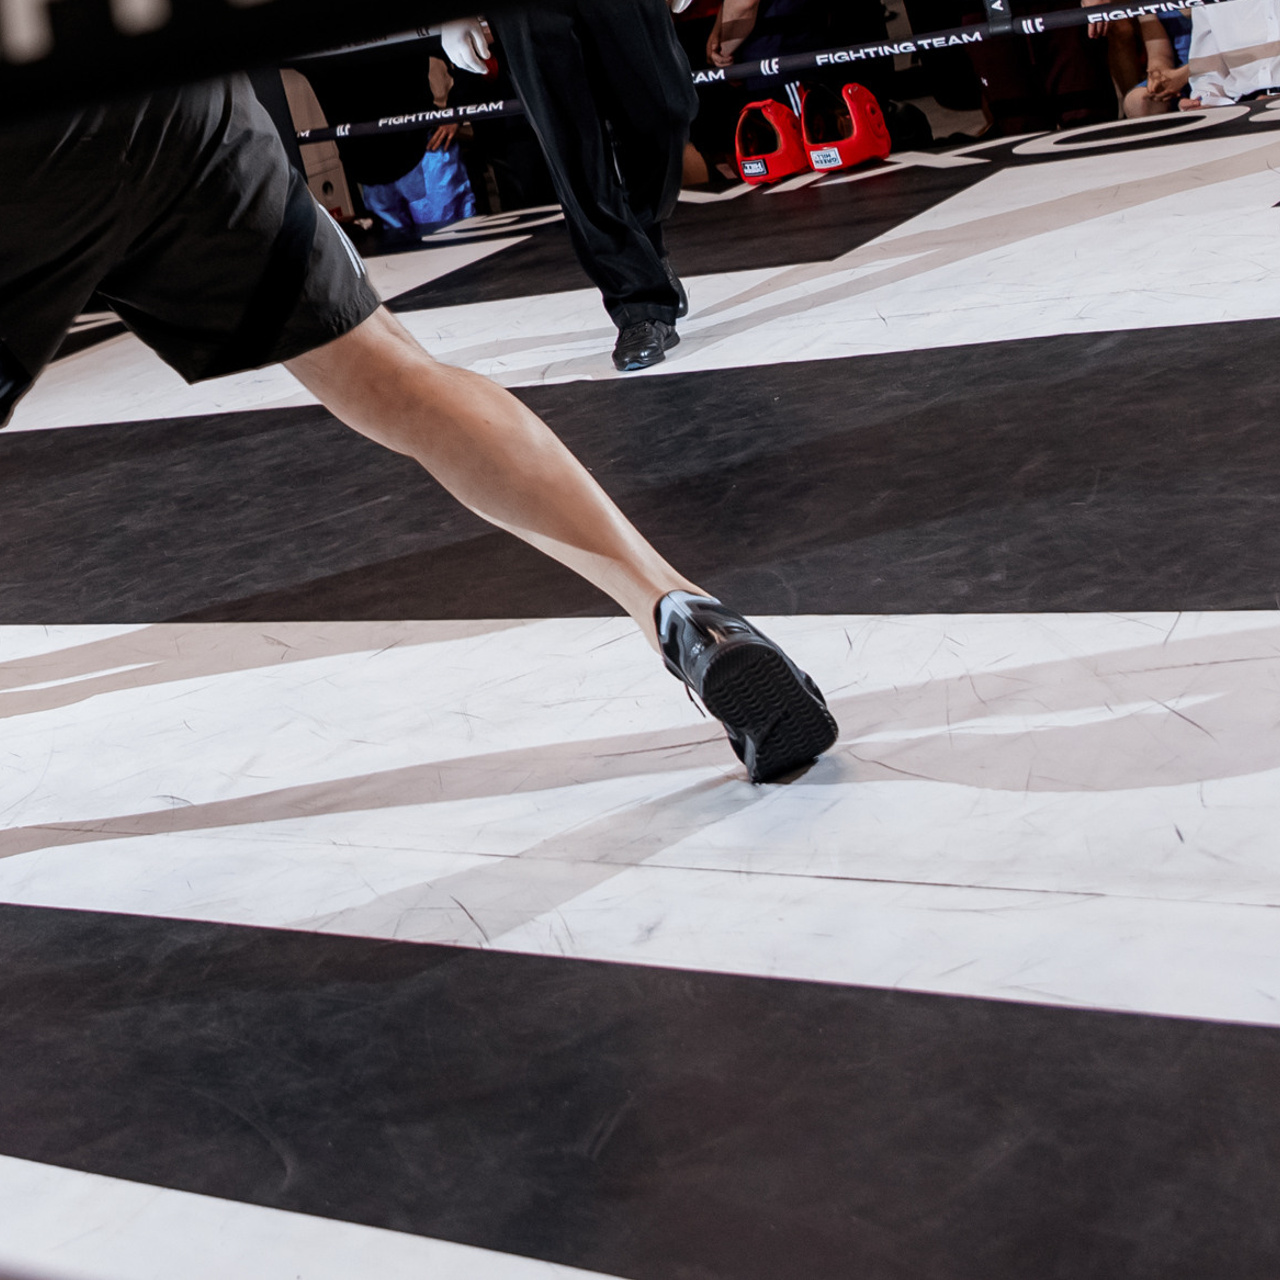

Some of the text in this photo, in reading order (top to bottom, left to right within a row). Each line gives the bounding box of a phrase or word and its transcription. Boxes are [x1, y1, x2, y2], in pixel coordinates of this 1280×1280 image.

[815, 30, 983, 66] FIGHTING TEAM
[378, 100, 504, 128] FIGHTING TEAM
